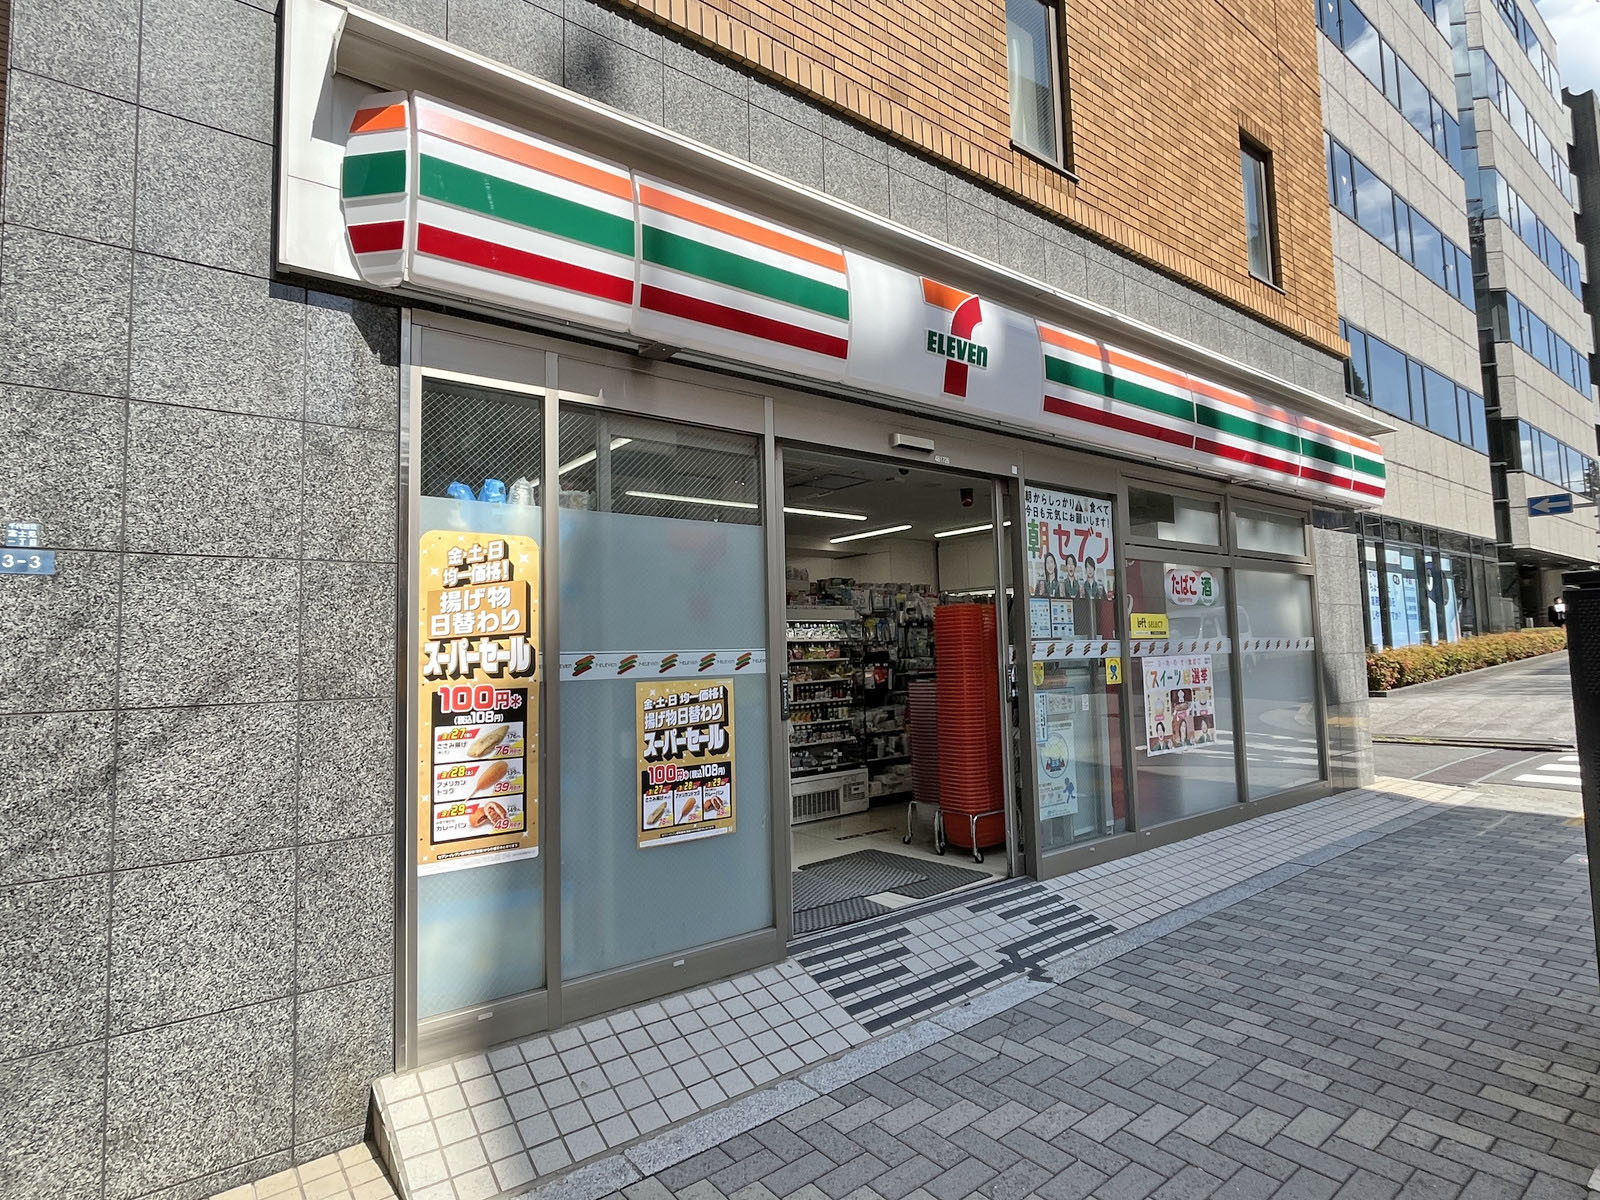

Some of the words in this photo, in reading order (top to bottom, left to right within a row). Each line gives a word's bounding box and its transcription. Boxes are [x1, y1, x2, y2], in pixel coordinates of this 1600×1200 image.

[1089, 501, 1109, 515] 食べて
[2, 554, 41, 568] 3-3
[1171, 574, 1197, 596] たばこ
[1201, 576, 1212, 597] 酒
[440, 586, 511, 614] 揚げ物
[431, 609, 521, 636] 日替わり
[424, 636, 532, 676] スーパーセール
[644, 703, 723, 730] 揚げ物日替わり
[643, 723, 725, 757] スーパーセール
